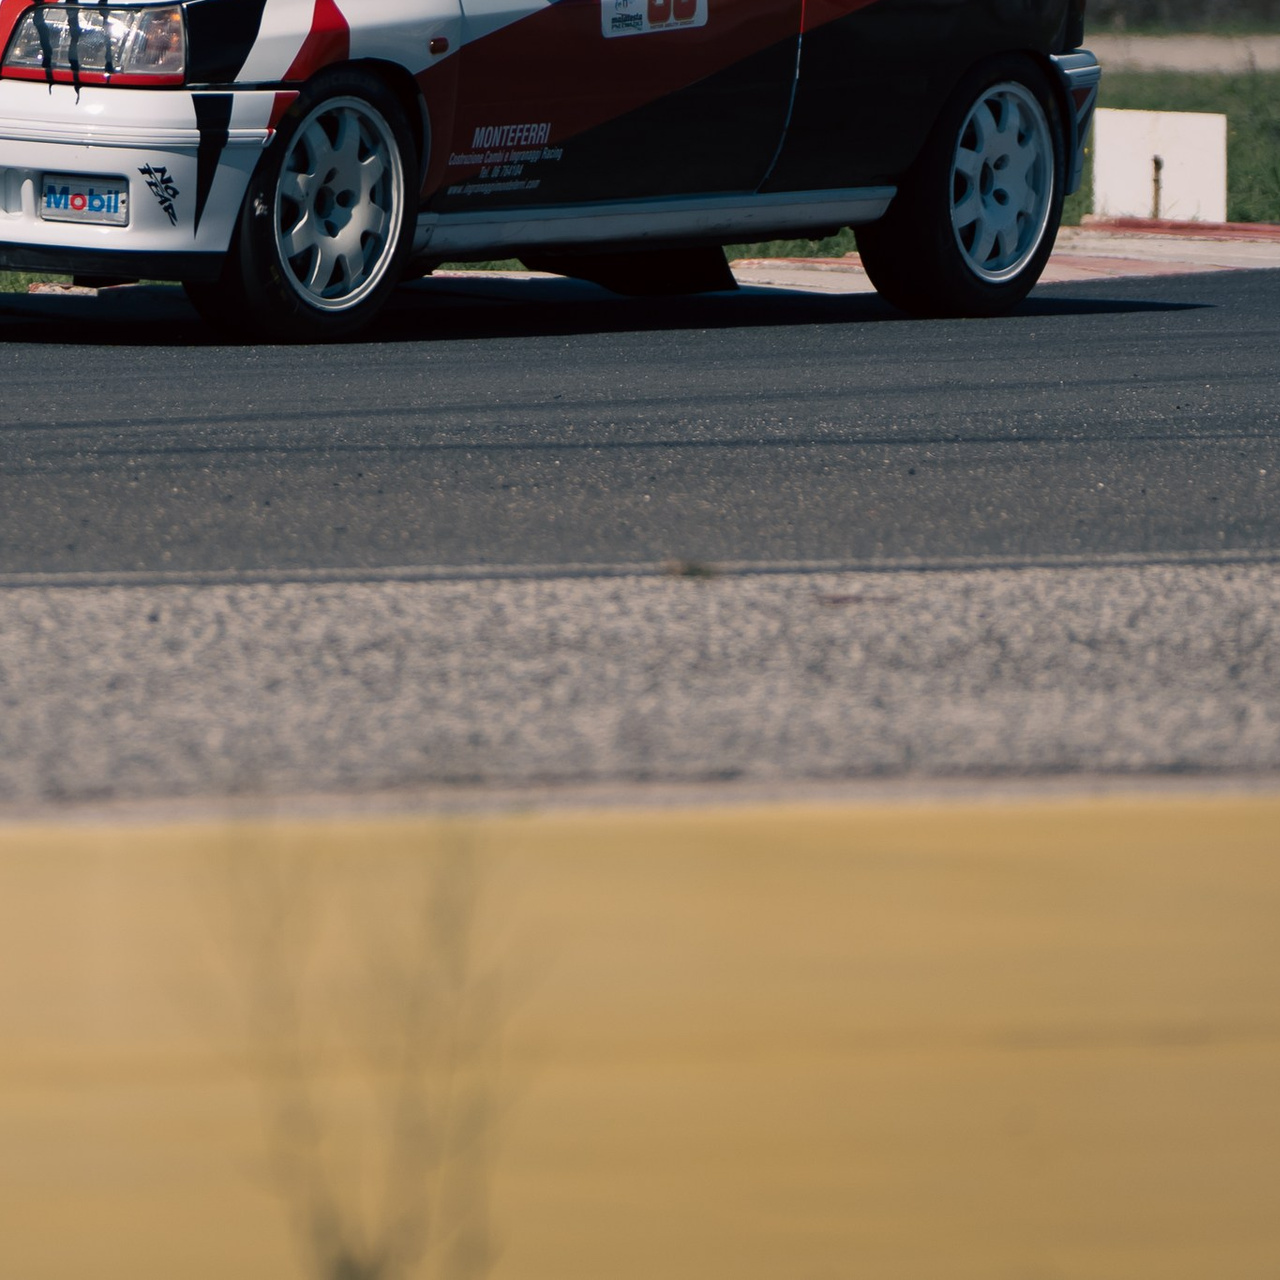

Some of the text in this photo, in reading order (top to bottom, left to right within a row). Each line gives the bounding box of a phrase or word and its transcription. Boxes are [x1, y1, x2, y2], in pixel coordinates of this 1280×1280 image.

[471, 122, 552, 149] MONTEFERRI
[541, 147, 563, 161] Racing
[46, 185, 119, 214] Mobil
